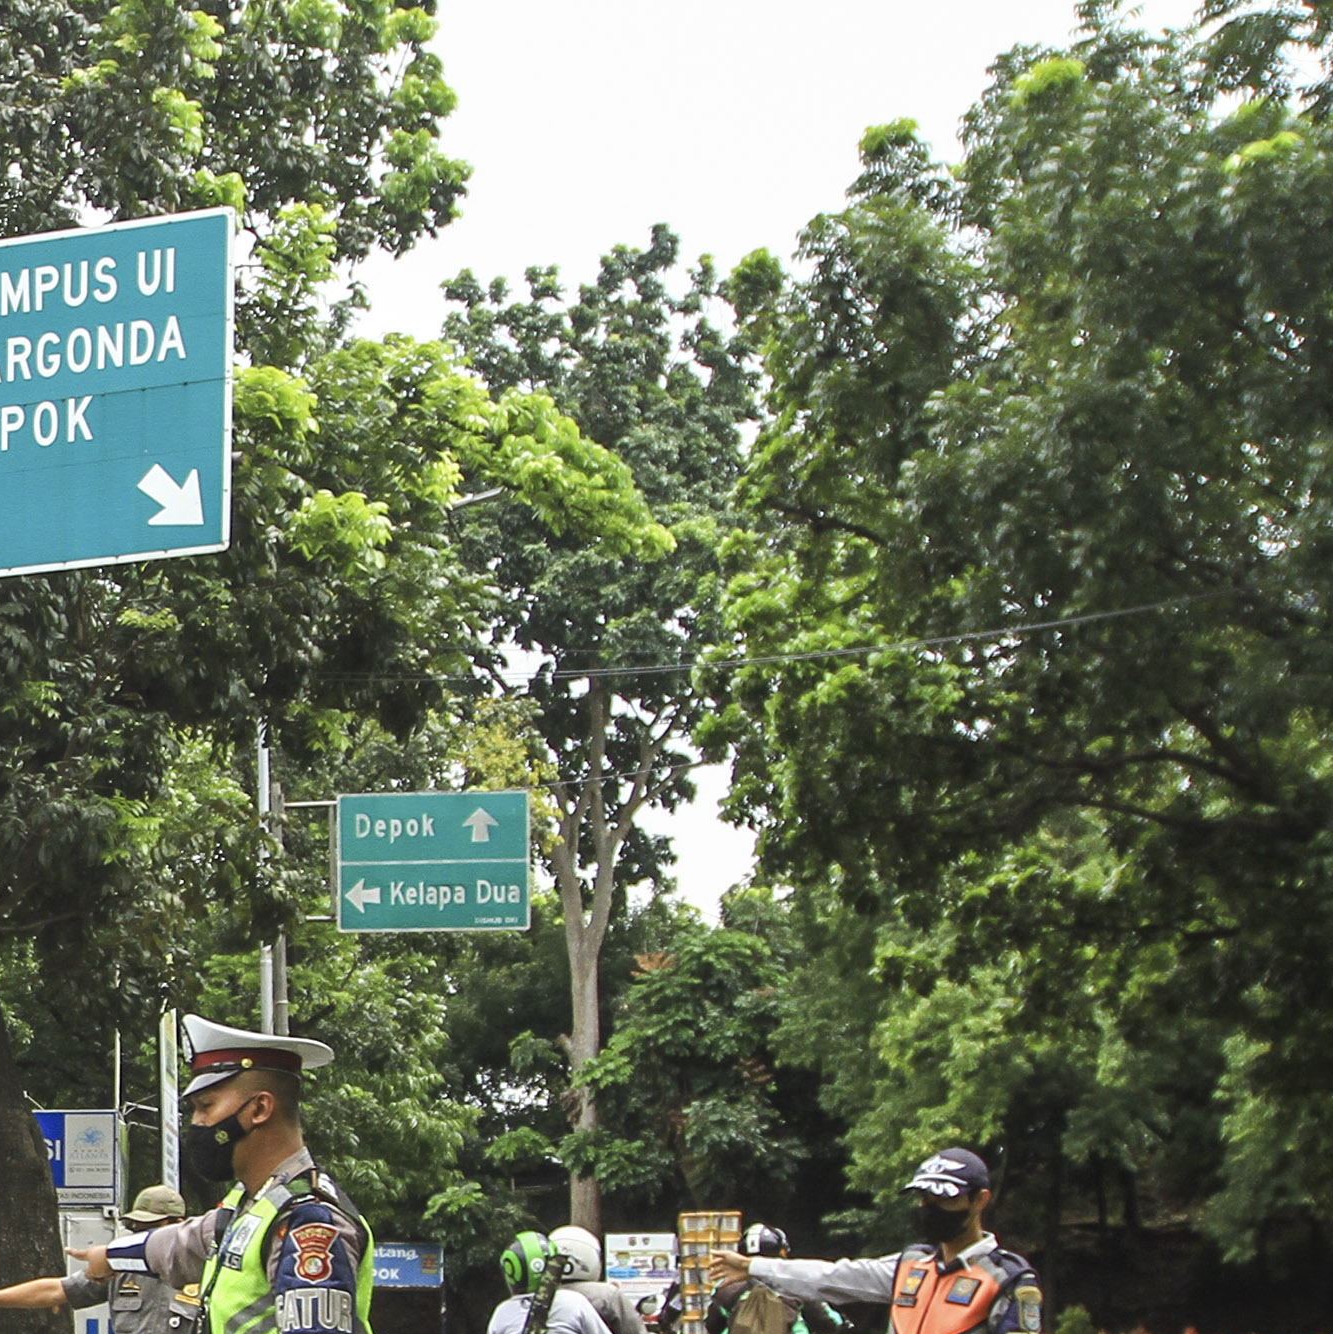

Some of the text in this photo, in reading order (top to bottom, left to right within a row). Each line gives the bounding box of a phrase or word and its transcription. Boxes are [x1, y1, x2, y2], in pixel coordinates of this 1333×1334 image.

[137, 247, 176, 297] UI
[355, 812, 436, 844] Depok
[390, 879, 521, 912] Kelapa Dua
[373, 1246, 419, 1261] atang
